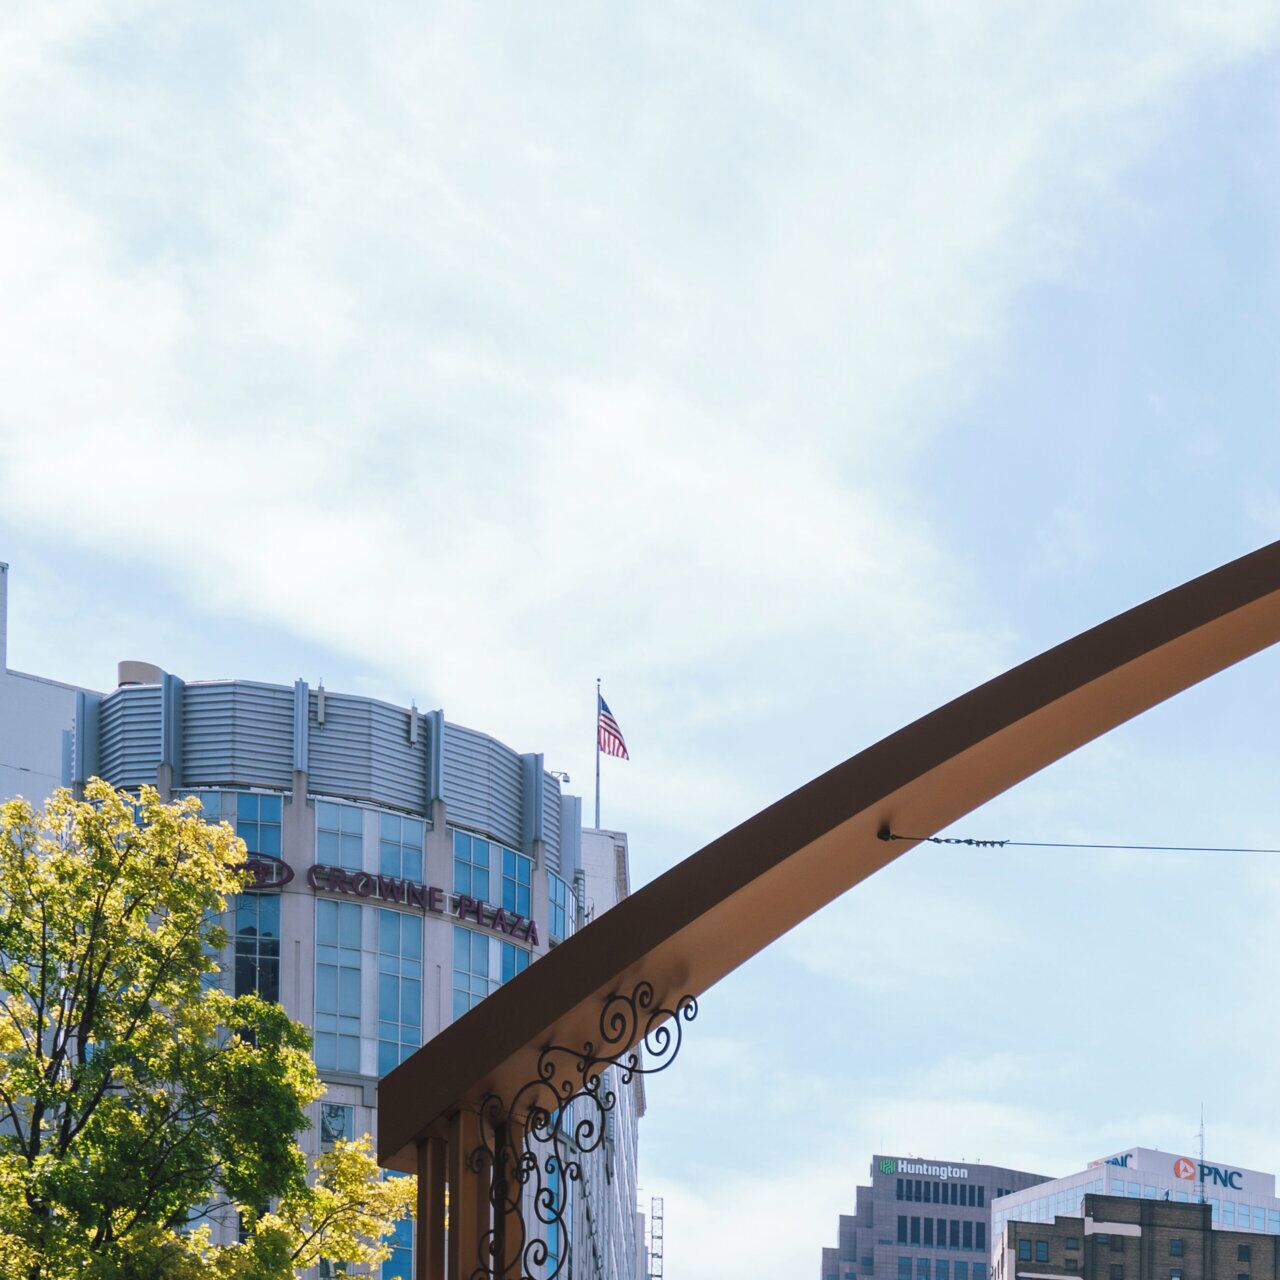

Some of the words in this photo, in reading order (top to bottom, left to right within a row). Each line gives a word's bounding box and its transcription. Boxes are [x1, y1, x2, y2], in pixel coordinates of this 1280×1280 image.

[307, 864, 444, 914] CROWNE
[457, 895, 539, 946] PLAZA
[896, 1159, 969, 1180] Huntington
[1198, 1164, 1243, 1191] PNC
